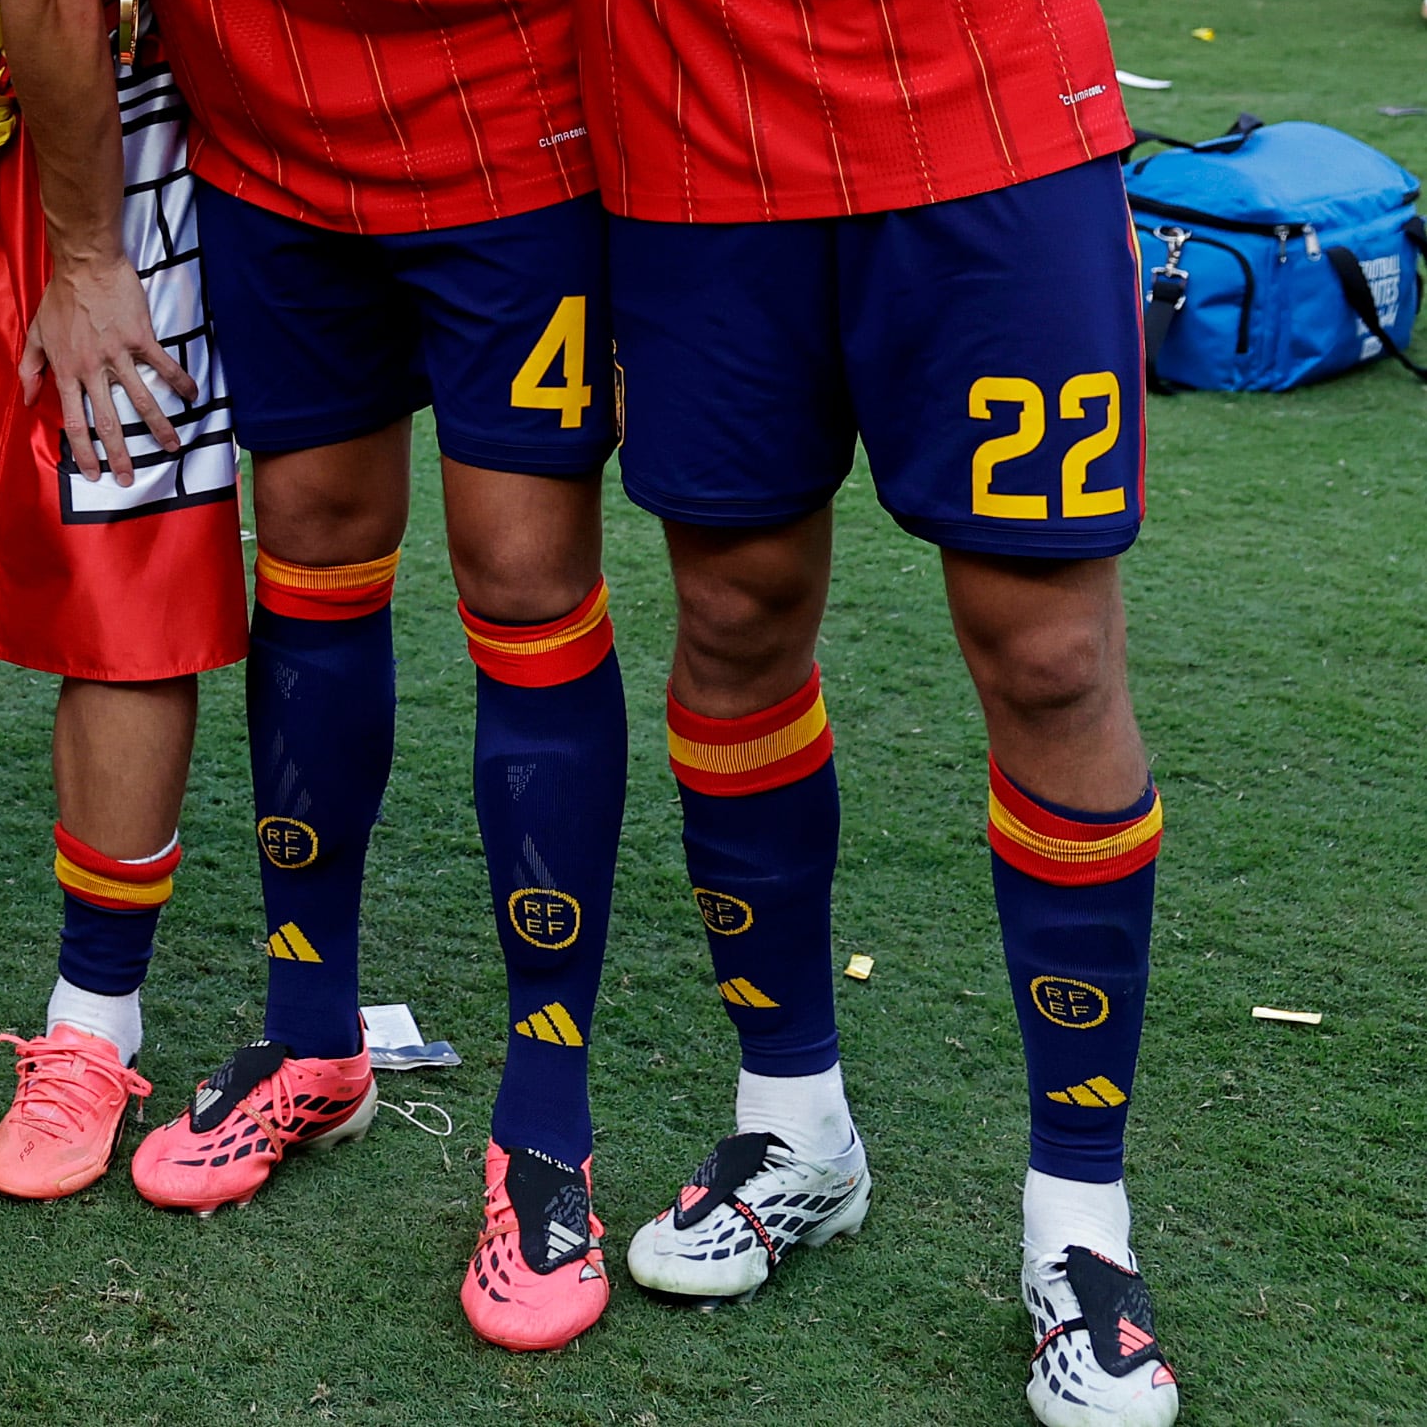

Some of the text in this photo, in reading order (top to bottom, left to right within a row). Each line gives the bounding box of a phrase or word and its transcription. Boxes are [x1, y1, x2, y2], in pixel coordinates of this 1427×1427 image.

[538, 127, 587, 148] CLIMACOOL
[510, 295, 592, 429] 4
[969, 371, 1126, 519] 22
[267, 828, 301, 844] RF
[268, 844, 301, 859] EF
[524, 900, 564, 917] RF
[700, 896, 733, 913] RF
[704, 908, 735, 926] EF
[526, 918, 565, 936] EF
[1044, 985, 1087, 1003] RF
[1049, 1000, 1090, 1018] EF
